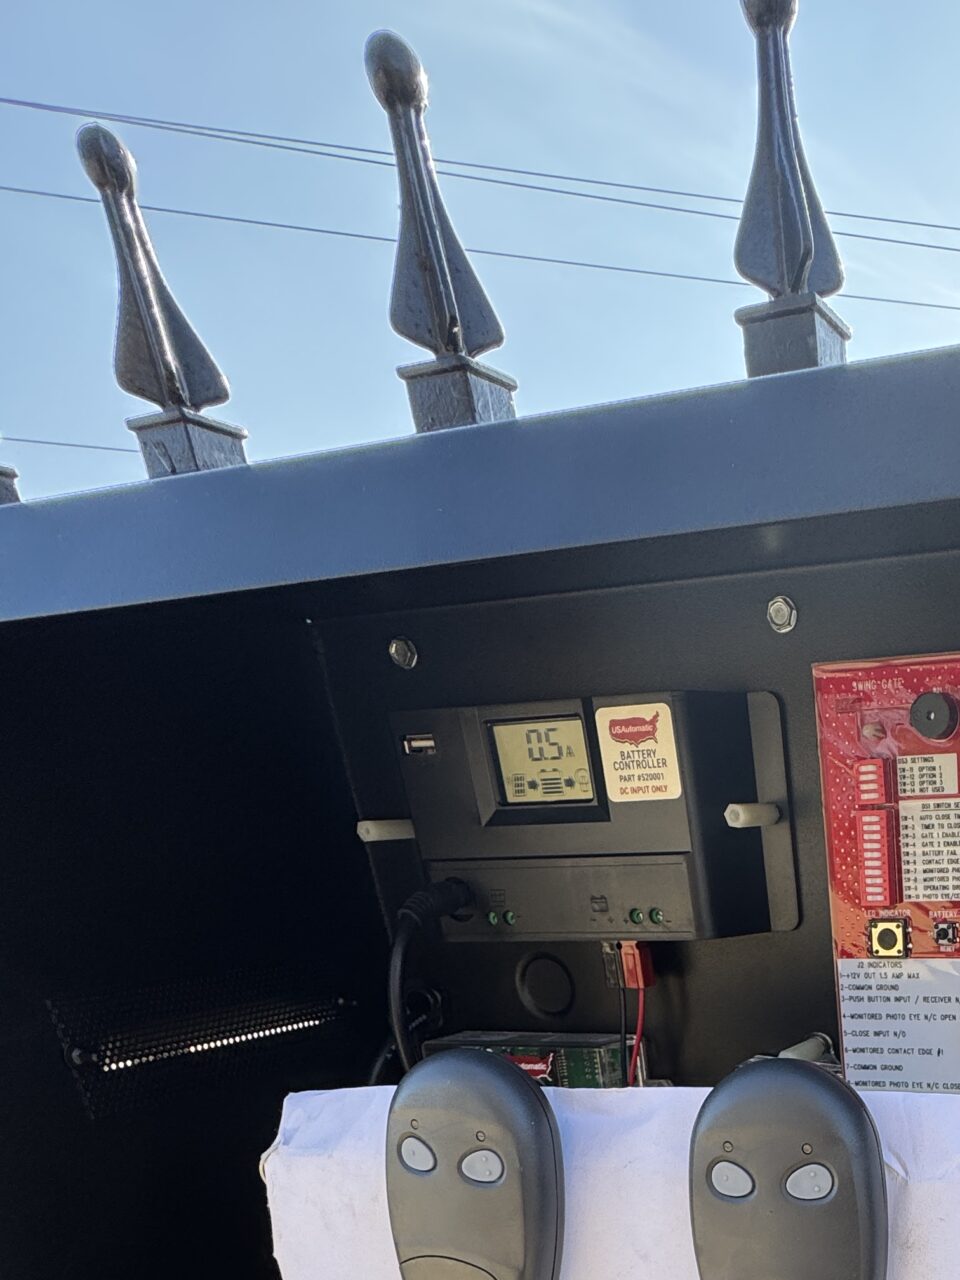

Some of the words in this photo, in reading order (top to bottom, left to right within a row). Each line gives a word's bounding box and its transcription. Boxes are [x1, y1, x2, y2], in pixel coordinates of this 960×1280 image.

[852, 680, 877, 691] SWING
[882, 678, 904, 689] GATE
[612, 724, 654, 734] USAutomatic
[620, 749, 657, 760] BATTERY
[613, 758, 667, 770] CONTROLLER
[619, 774, 635, 782] PART
[637, 773, 664, 781] #520001
[620, 787, 630, 795] DC
[631, 786, 649, 794] INPUT
[652, 785, 668, 793] ONLY
[924, 1014, 937, 1022] N/C
[873, 1030, 890, 1038] INPUT
[893, 1030, 906, 1039] N/O
[927, 1081, 939, 1090] N/C
